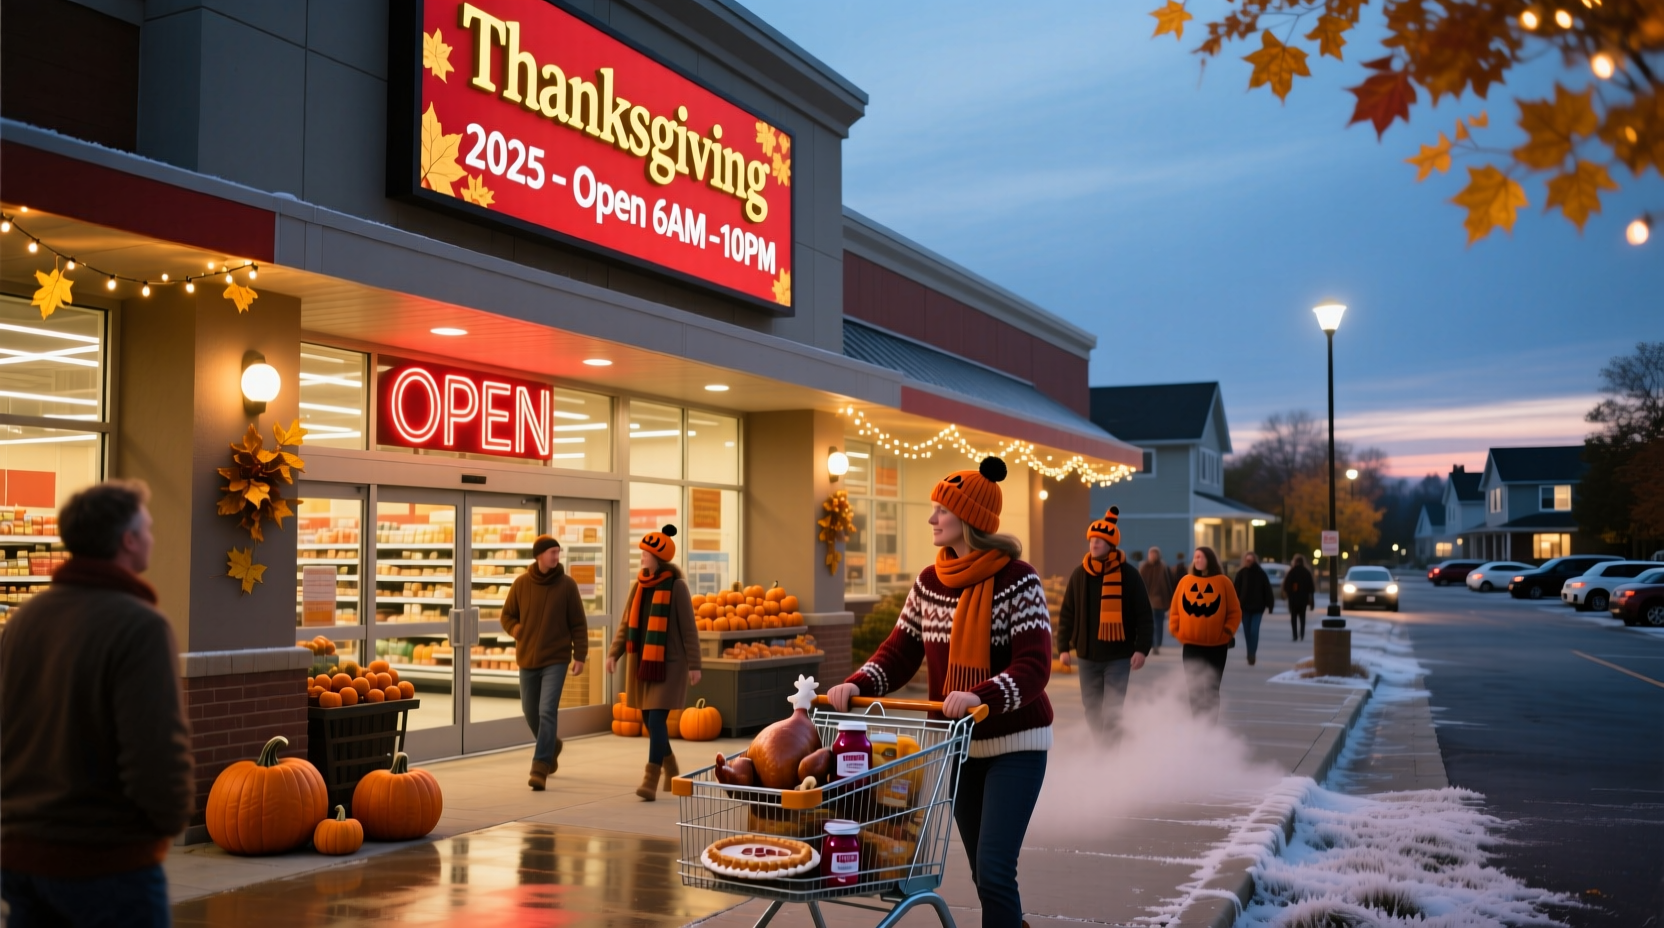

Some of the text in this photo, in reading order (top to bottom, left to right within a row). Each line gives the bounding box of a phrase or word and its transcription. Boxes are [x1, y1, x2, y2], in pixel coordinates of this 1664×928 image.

[462, 2, 770, 223] Thanksgiving
[465, 123, 545, 189] 2025
[573, 165, 646, 228] Open
[391, 367, 550, 456] OPEN
